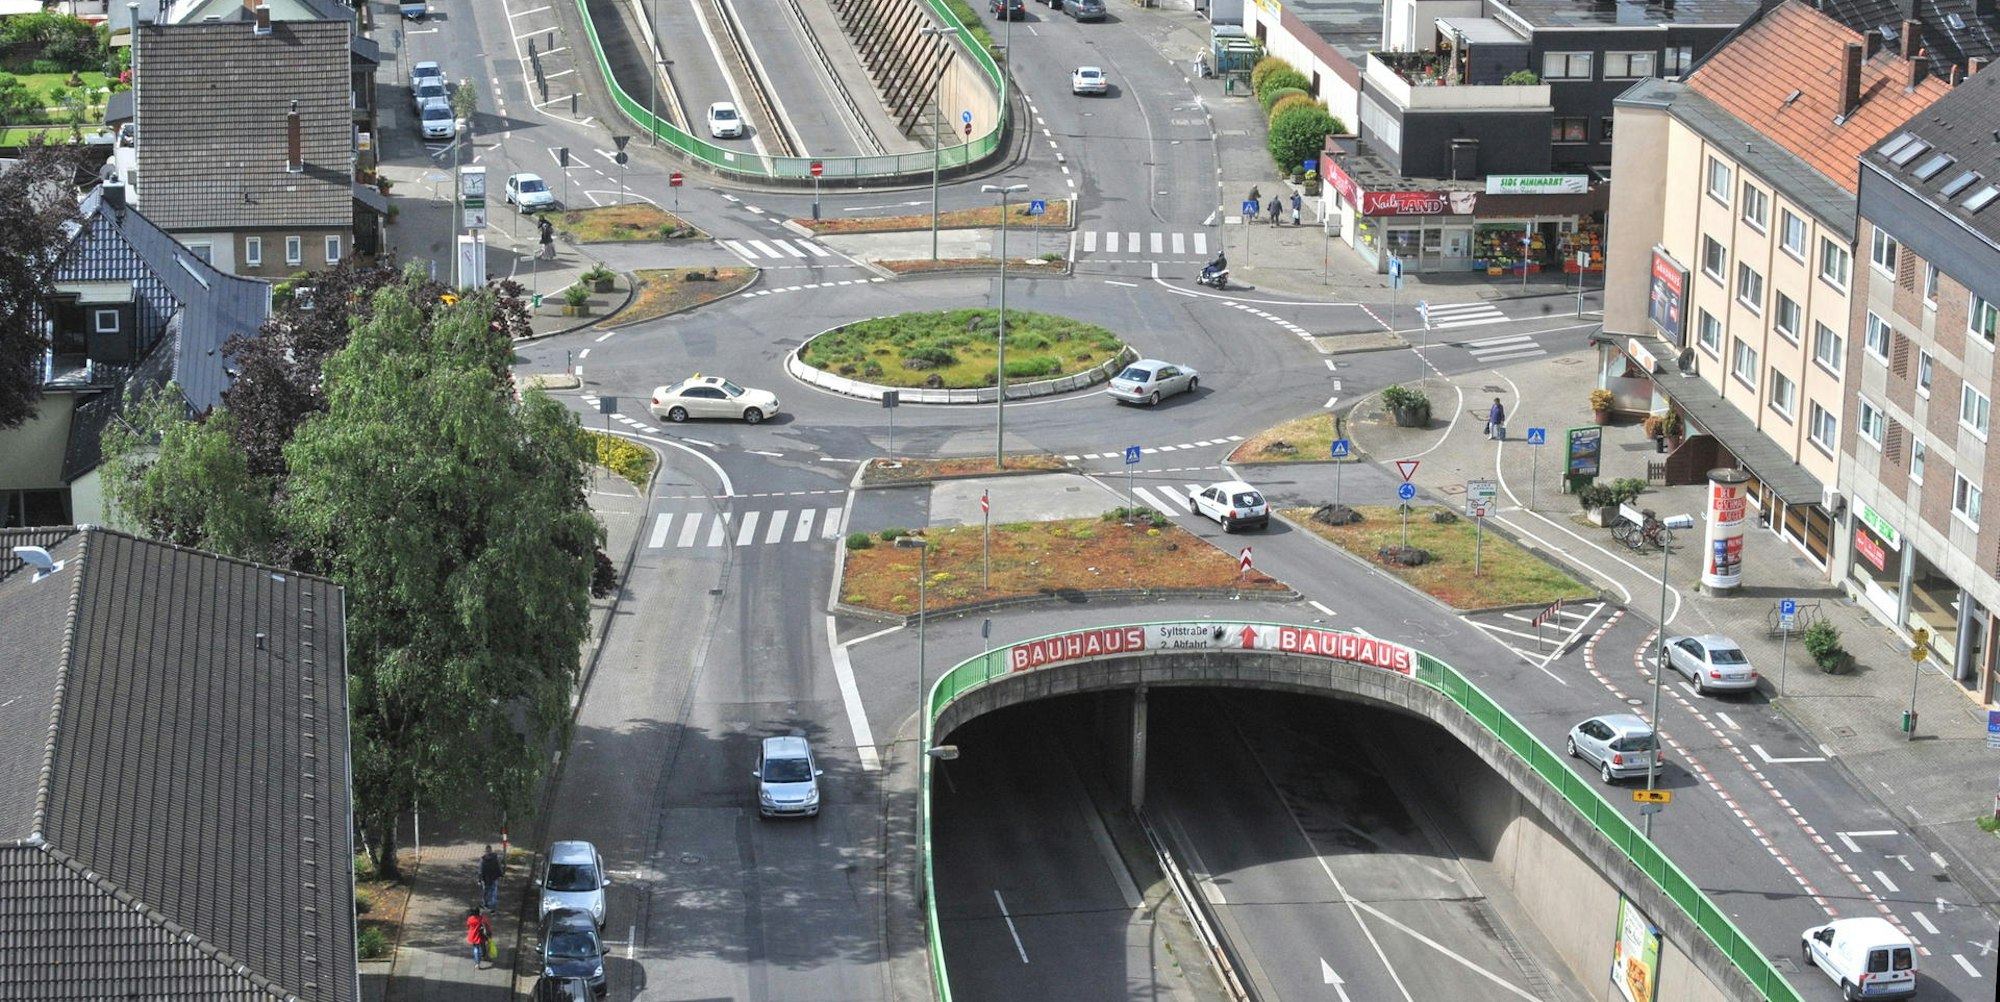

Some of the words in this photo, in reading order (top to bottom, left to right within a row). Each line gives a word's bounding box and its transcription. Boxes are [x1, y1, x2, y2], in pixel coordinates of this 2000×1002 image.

[1520, 177, 1564, 186] MINIMARKT
[1364, 194, 1397, 214] Nails
[1396, 199, 1443, 214] LAND
[1784, 602, 1792, 612] P
[1160, 627, 1208, 638] Syltstraße
[1160, 640, 1170, 649] 2.
[1173, 637, 1207, 649] Abfahrt
[1015, 630, 1142, 669] BAUHAUS
[1282, 630, 1409, 669] BAUHAUS
